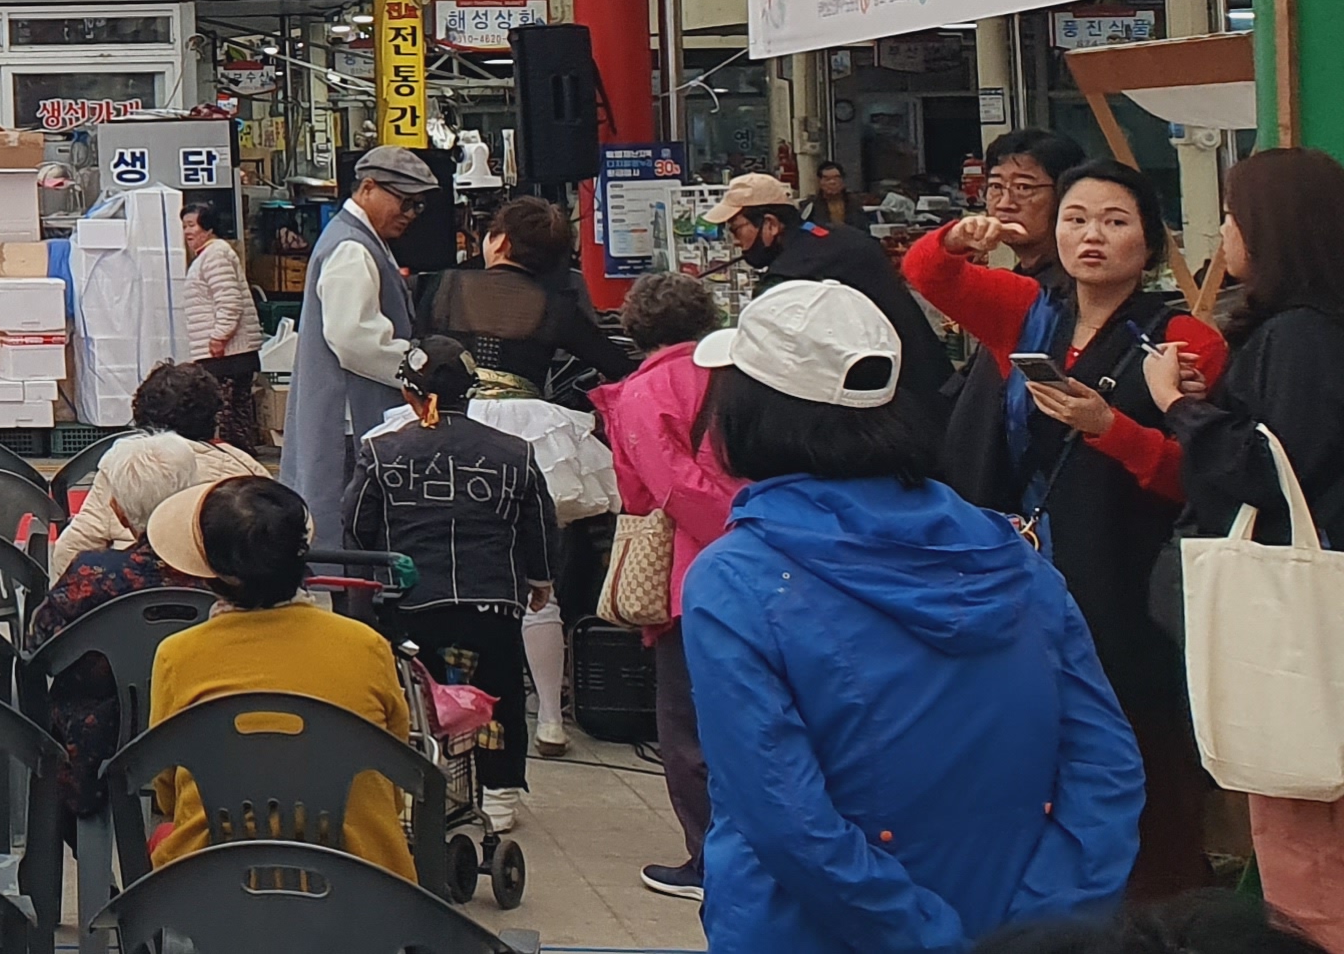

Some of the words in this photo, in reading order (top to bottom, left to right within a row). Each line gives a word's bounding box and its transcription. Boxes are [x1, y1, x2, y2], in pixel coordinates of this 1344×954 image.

[448, 9, 535, 30] 해성상회
[1062, 19, 1149, 38] 풍진식품
[388, 25, 421, 137] 전통간
[113, 149, 148, 185] 생
[180, 148, 218, 185] 닭
[382, 452, 518, 519] 한심해
